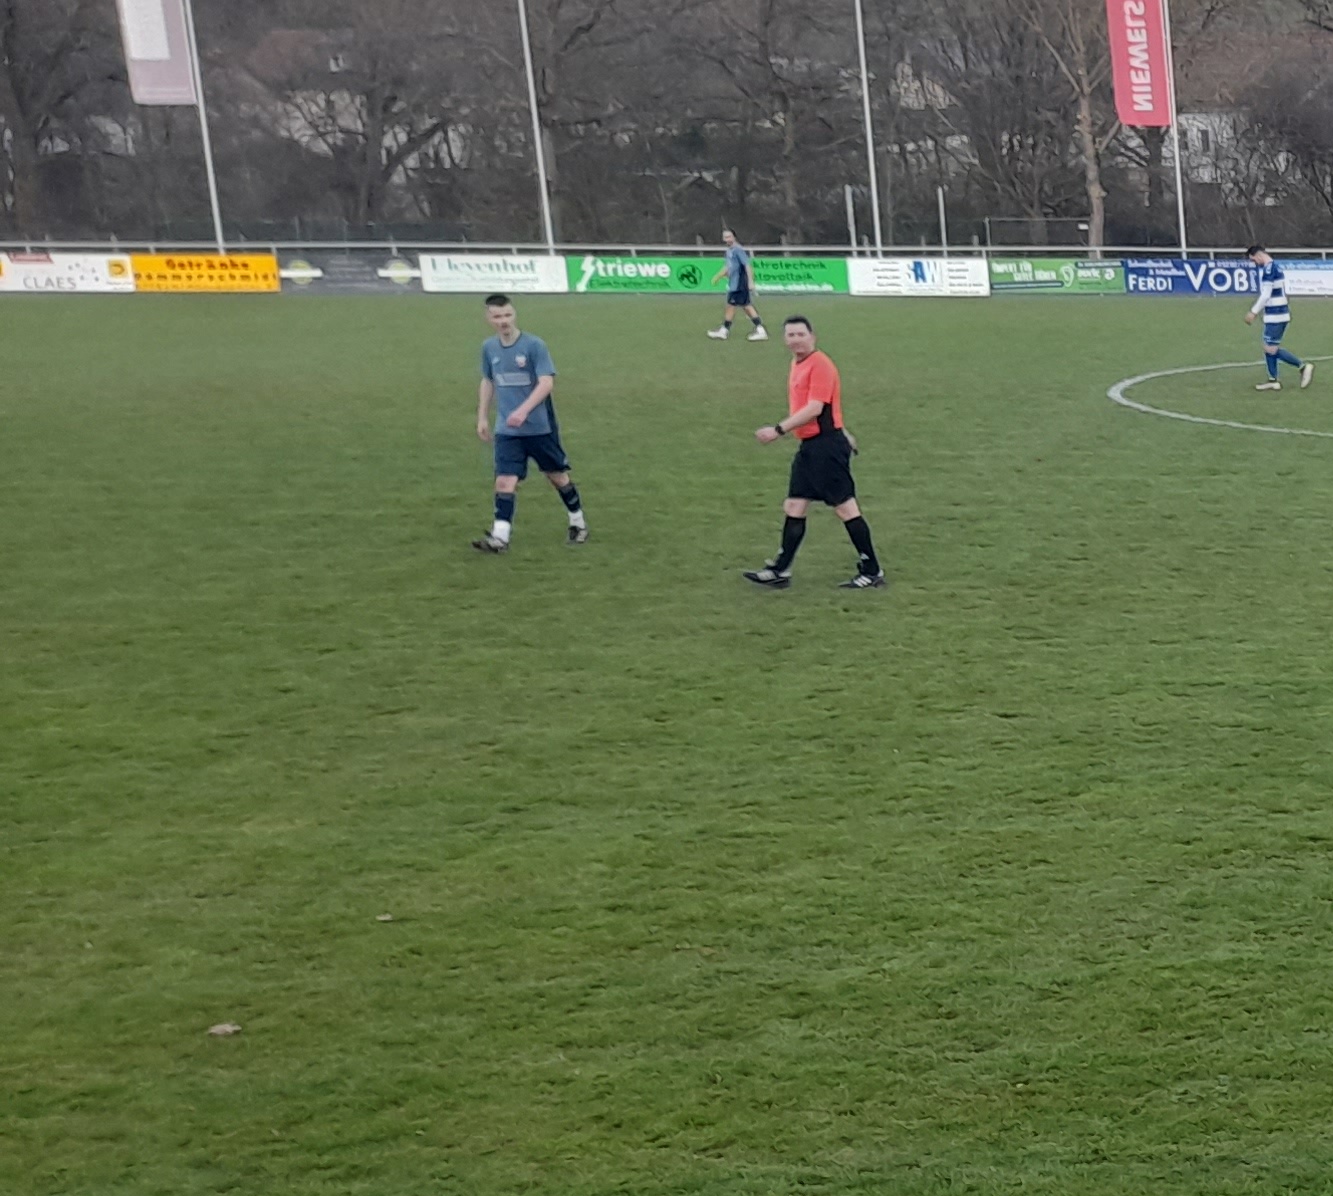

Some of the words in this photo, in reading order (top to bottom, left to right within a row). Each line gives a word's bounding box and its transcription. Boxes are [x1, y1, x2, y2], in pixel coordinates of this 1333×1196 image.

[165, 258, 249, 270] Getränke
[752, 260, 827, 270] ktrotechnik
[23, 276, 77, 290] CLAES
[1127, 274, 1173, 291] FERDI
